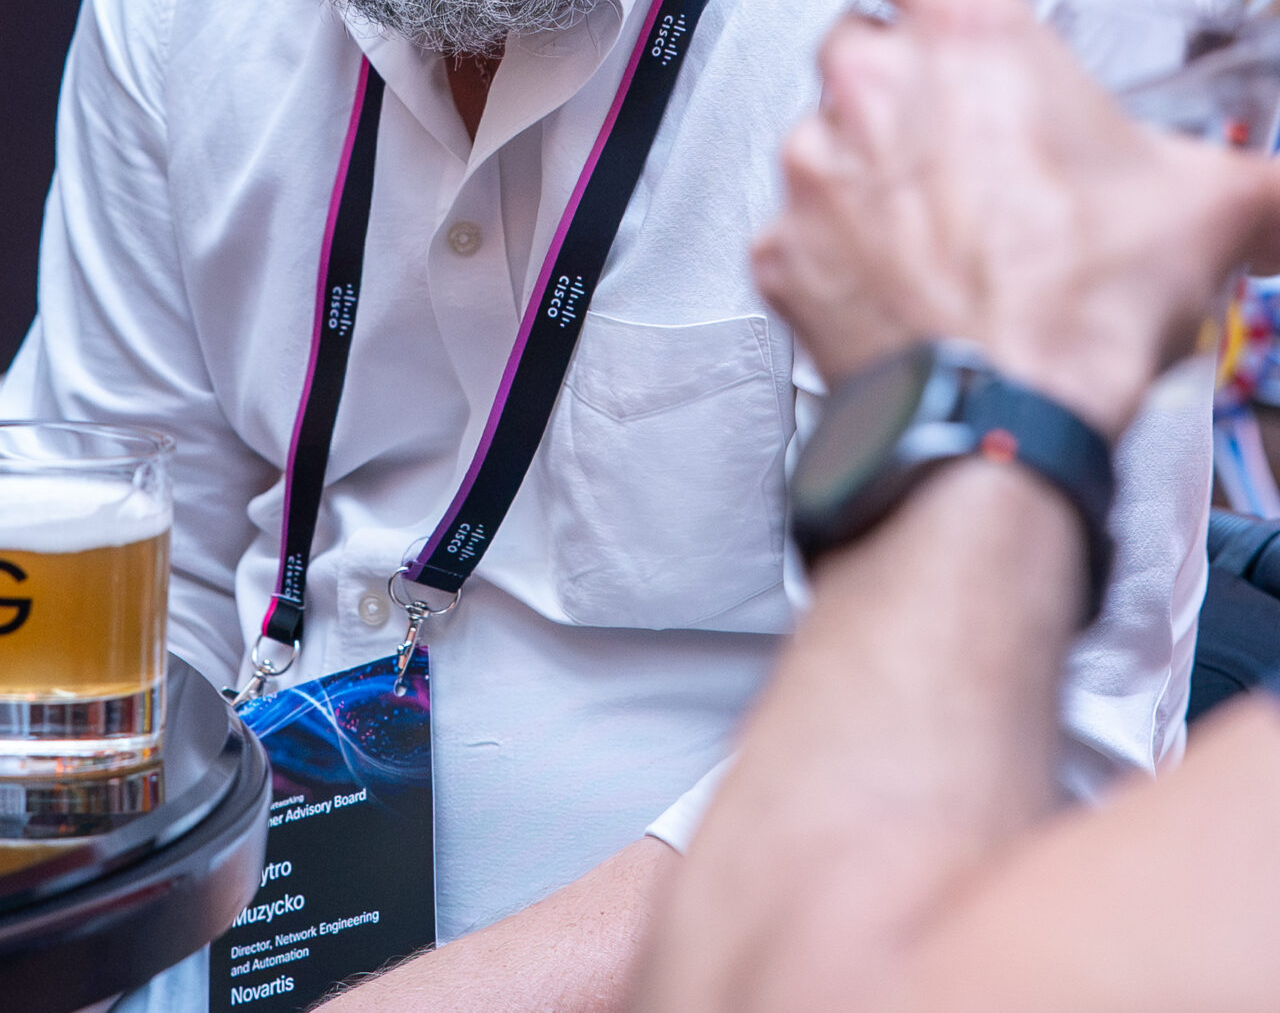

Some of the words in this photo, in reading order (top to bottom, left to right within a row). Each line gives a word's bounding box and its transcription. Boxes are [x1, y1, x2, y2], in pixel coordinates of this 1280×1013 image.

[285, 800, 332, 823] Advisory
[334, 787, 367, 809] Board
[261, 860, 292, 887] ytro
[232, 893, 305, 928] Muzycko
[230, 939, 273, 960] Director,
[275, 925, 317, 948] Network
[319, 910, 380, 935] Engineering
[230, 960, 250, 978] and
[251, 947, 309, 971] Automation
[230, 974, 295, 1007] Novartis
